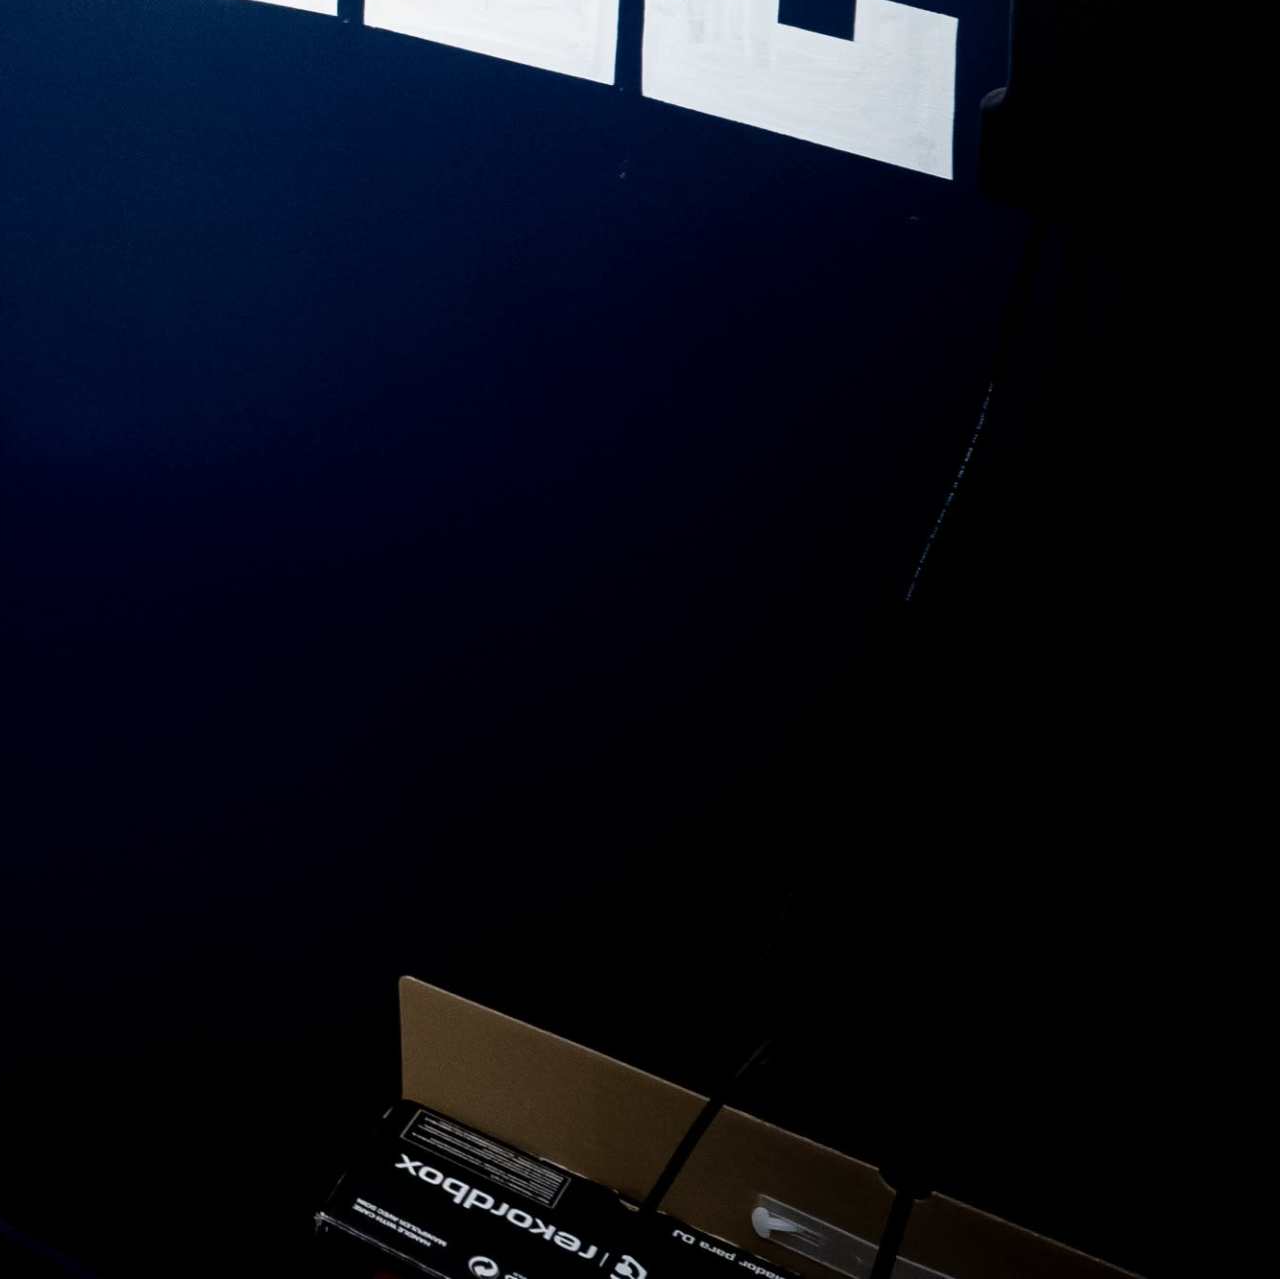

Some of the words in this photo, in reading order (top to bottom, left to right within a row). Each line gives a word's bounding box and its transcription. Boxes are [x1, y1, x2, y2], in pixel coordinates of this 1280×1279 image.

[393, 1152, 599, 1261] rekordbox
[671, 1228, 697, 1249] DJ
[699, 1239, 737, 1262] para
